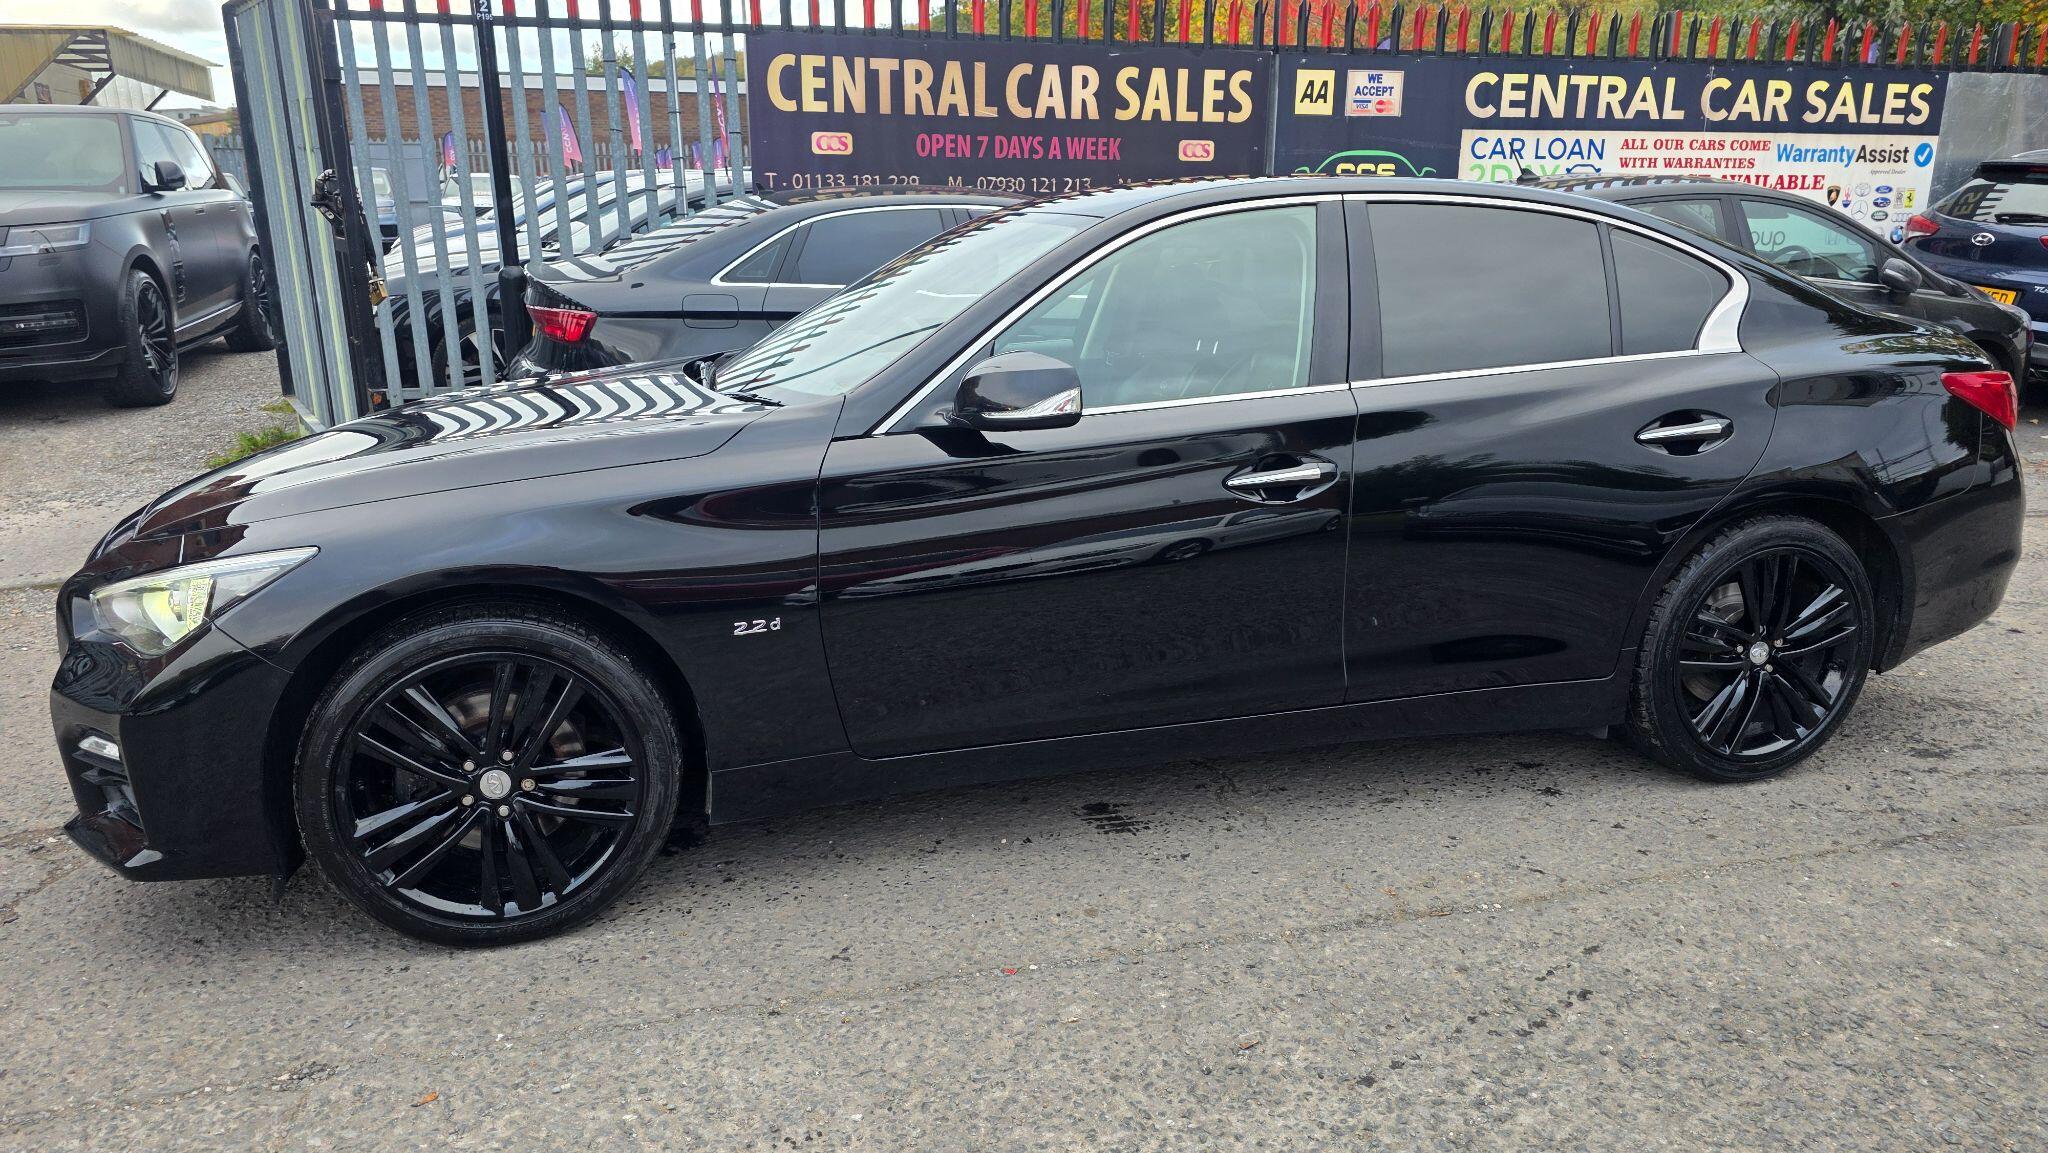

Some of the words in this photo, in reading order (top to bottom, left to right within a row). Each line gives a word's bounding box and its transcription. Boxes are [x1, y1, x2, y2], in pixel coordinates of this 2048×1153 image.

[766, 53, 998, 118] CENTRAL
[1006, 63, 1100, 120] CAR
[1115, 66, 1253, 123] SALES
[1367, 73, 1383, 84] WE
[1299, 80, 1328, 103] AA
[1354, 86, 1394, 97] ACCEPT
[1465, 71, 1685, 121] CENTRAL
[1701, 77, 1792, 123] CAR
[1803, 80, 1933, 126] SALES
[916, 133, 970, 159] OPEN
[976, 135, 989, 159] 7
[994, 136, 1043, 160] DAYS
[1048, 137, 1062, 160] A
[1066, 137, 1122, 160] WEEK
[1470, 136, 1526, 160] CAR
[1534, 137, 1606, 161] LOAN
[1620, 138, 1648, 150] ALL
[1653, 139, 1684, 151] OUR
[1689, 139, 1726, 151] CARS
[1730, 140, 1771, 152] COME
[1619, 157, 1658, 169] WITH
[1663, 157, 1756, 169] WARRANTIES
[764, 172, 778, 188] T
[792, 173, 846, 189] 01133
[948, 176, 963, 188] M
[977, 176, 1025, 192] 07930
[1031, 177, 1056, 192] 121
[1063, 178, 1091, 192] 213
